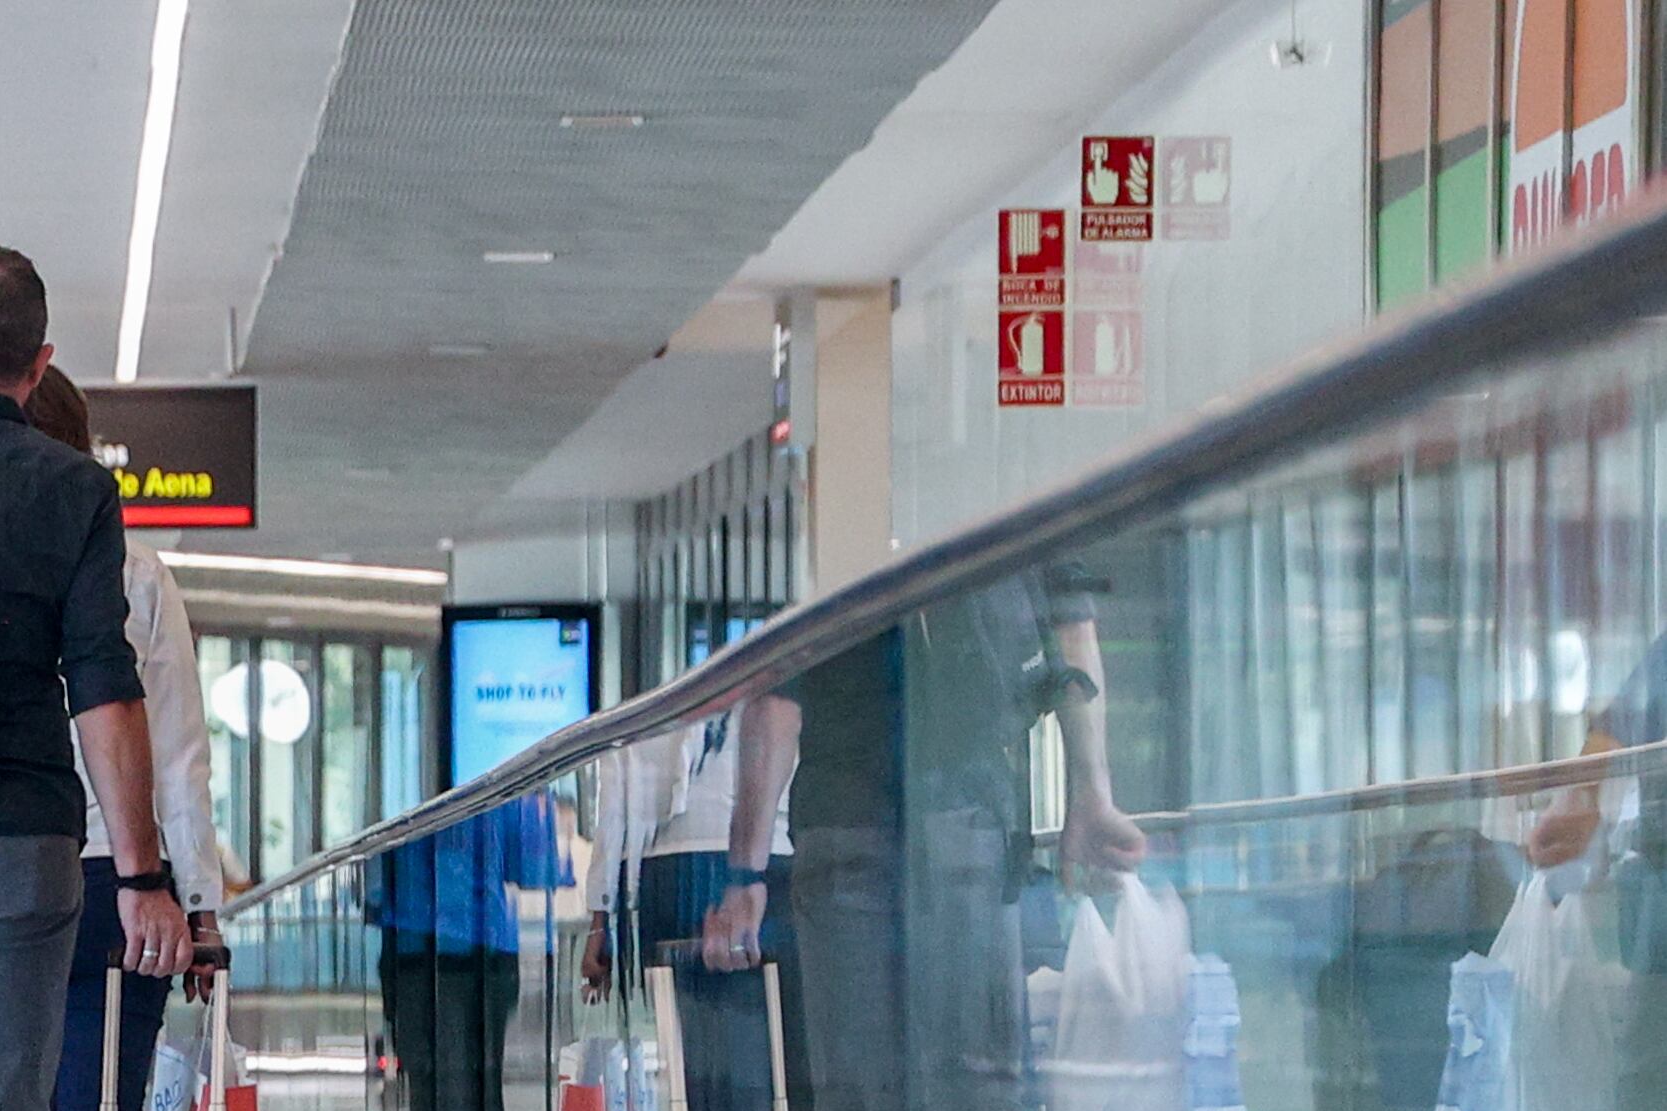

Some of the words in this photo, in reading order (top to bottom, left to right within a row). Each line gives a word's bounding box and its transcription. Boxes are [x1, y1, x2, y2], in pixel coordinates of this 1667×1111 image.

[1001, 384, 1062, 401] EXTINTOR
[142, 466, 213, 498] Aena
[476, 684, 512, 701] SHOP
